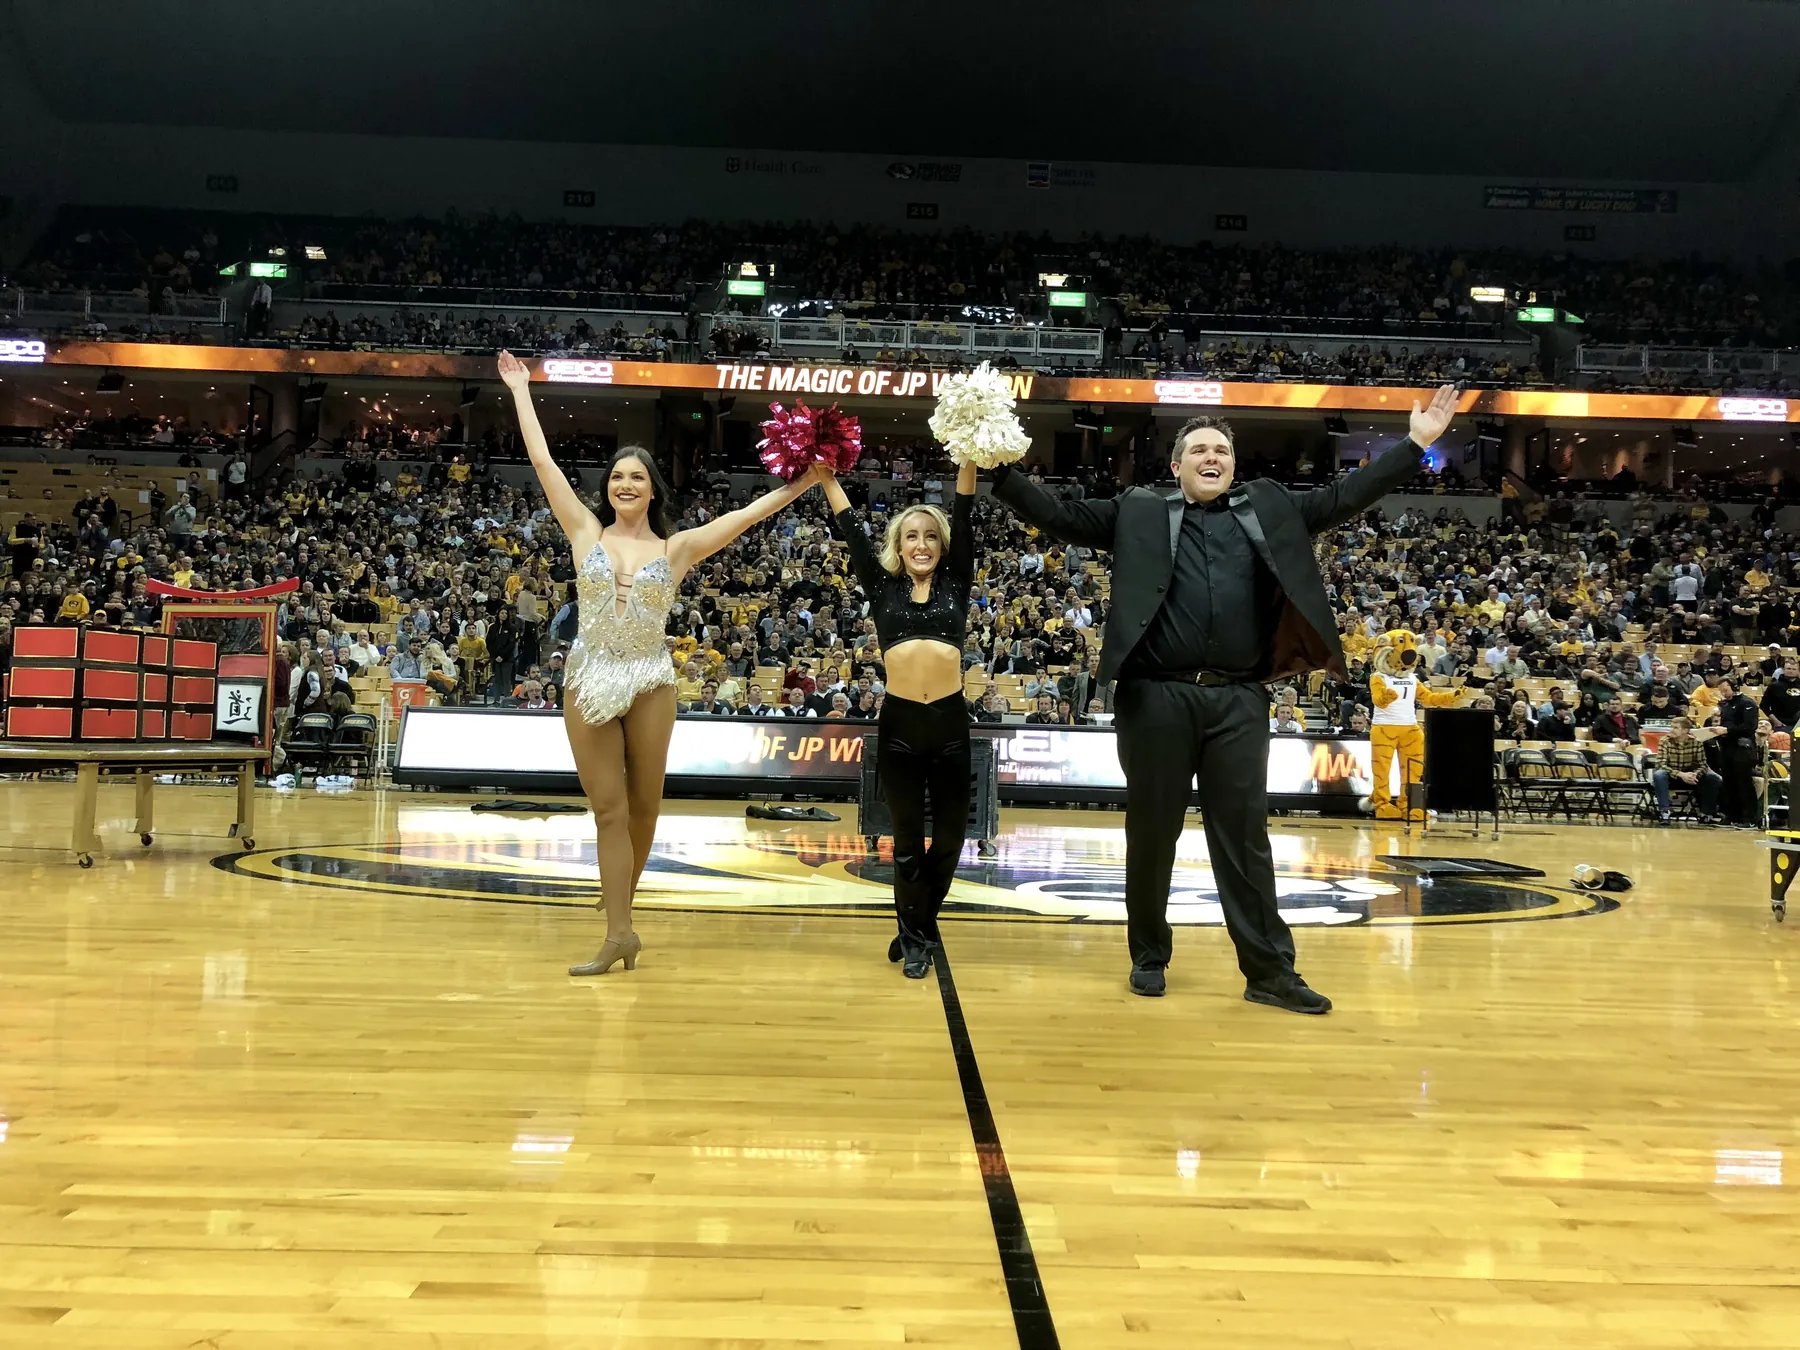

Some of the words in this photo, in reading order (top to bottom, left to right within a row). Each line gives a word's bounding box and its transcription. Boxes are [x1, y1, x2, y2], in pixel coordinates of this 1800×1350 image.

[544, 360, 613, 376] GEICO
[716, 365, 766, 390] THE
[768, 367, 853, 393] MAGIC
[857, 370, 892, 396] OF
[892, 371, 926, 396] JP
[1154, 382, 1222, 397] GEICO
[1718, 399, 1787, 414] GEICO
[399, 689, 410, 700] G
[1402, 686, 1408, 700] 1
[221, 689, 253, 725] 道
[788, 736, 824, 761] JP
